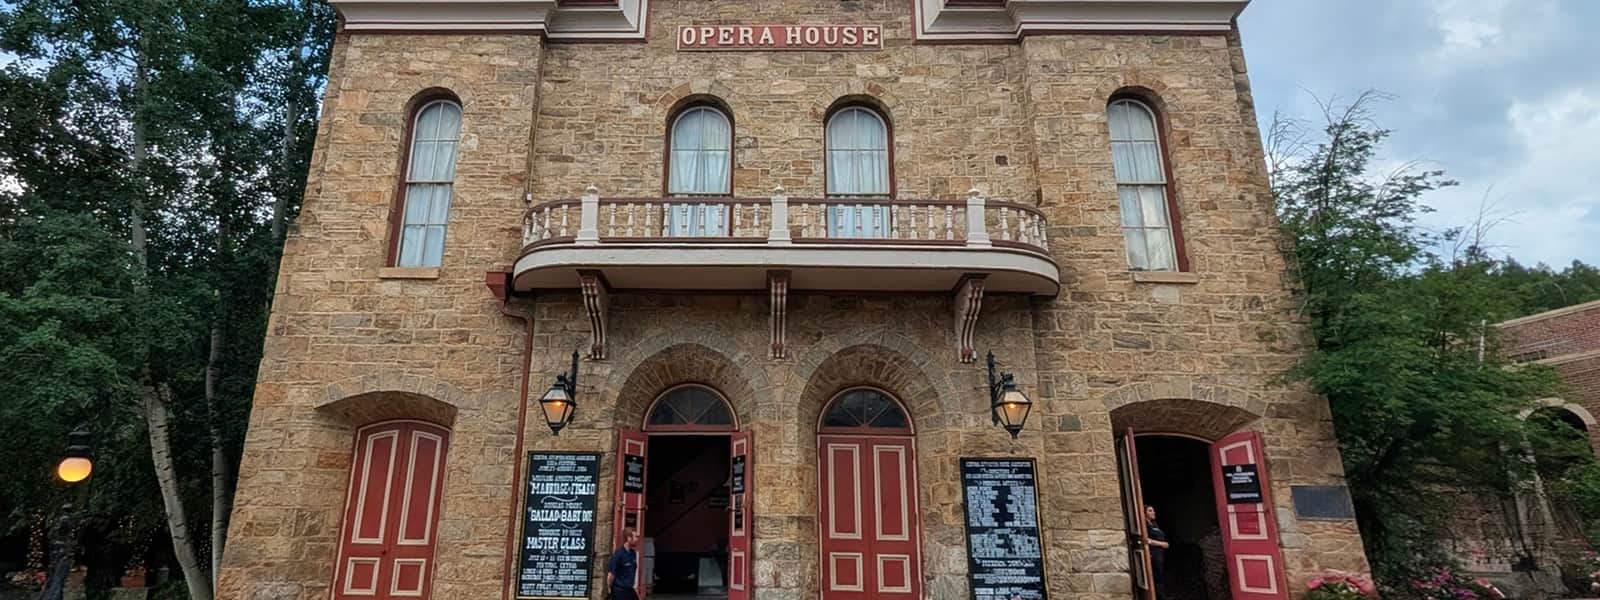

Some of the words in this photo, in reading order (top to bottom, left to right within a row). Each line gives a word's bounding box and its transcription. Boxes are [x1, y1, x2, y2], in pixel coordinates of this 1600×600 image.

[682, 27, 774, 45] OPERA
[786, 27, 879, 45] HOUSE
[531, 509, 560, 522] BALLAD
[561, 510, 581, 522] BABY
[526, 537, 559, 549] MASTER
[560, 537, 586, 550] CLASS
